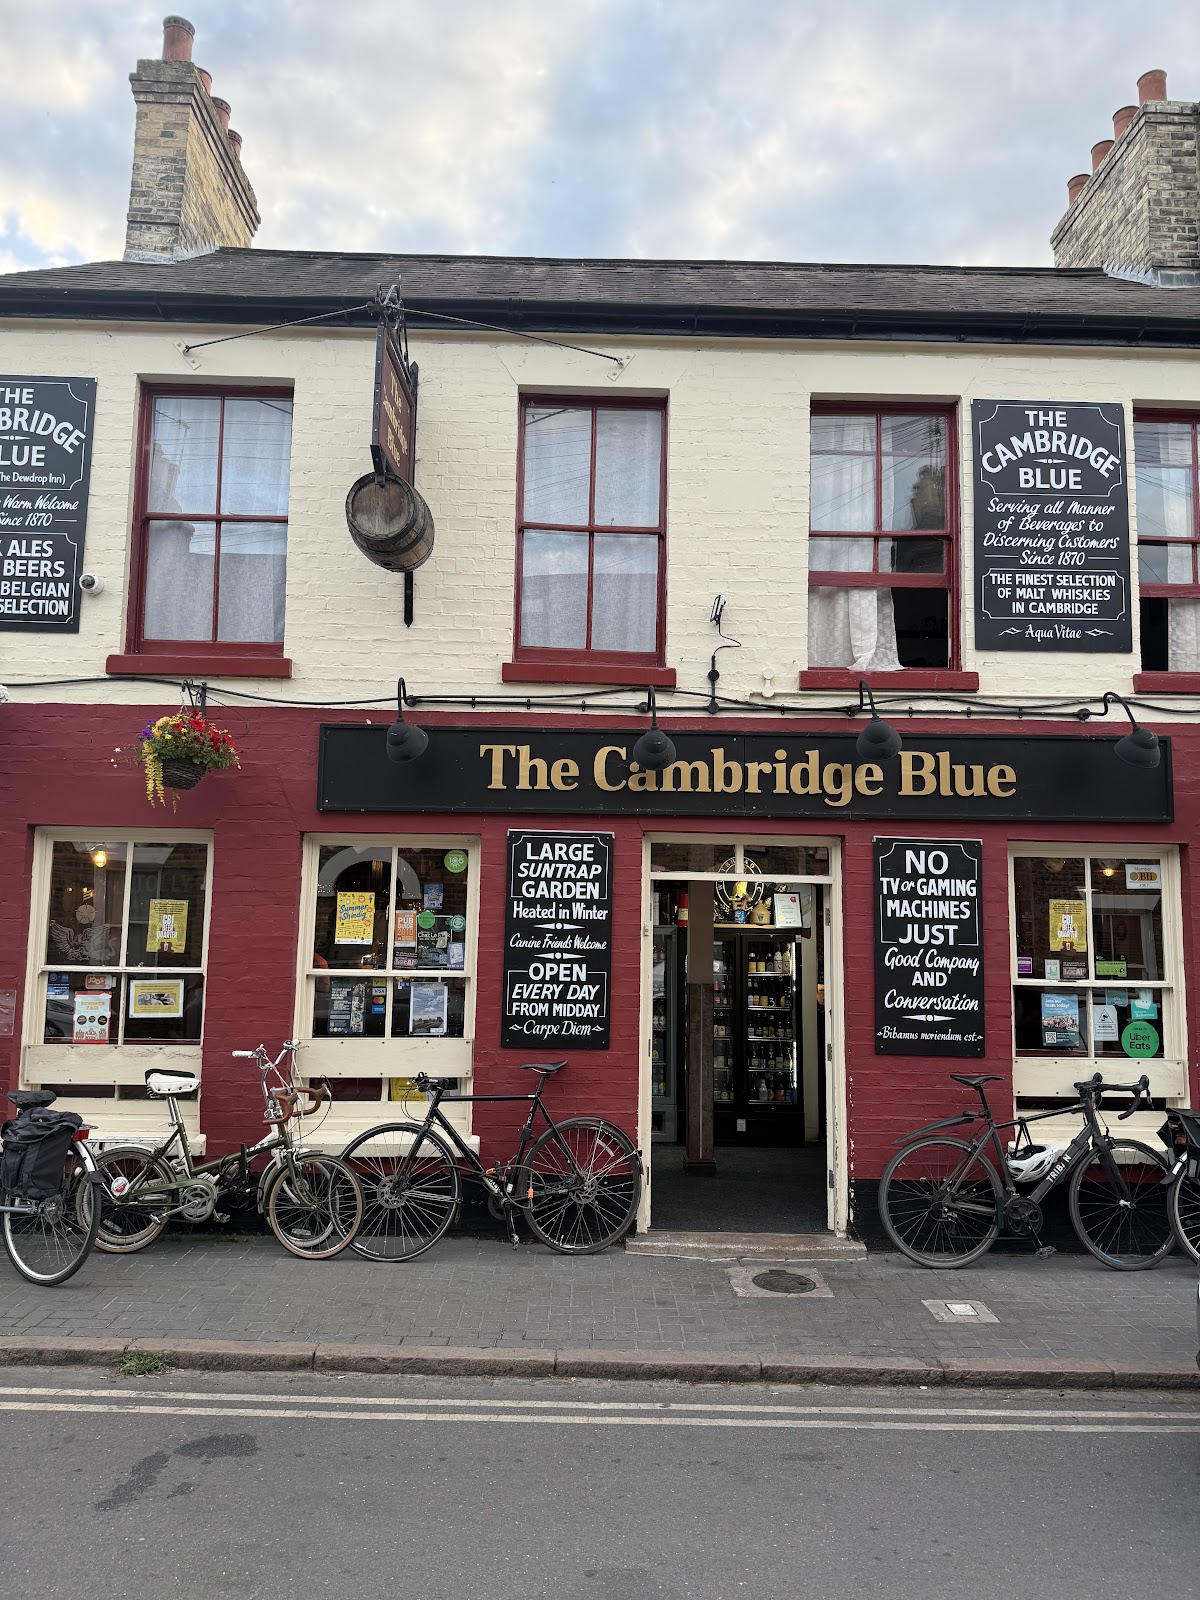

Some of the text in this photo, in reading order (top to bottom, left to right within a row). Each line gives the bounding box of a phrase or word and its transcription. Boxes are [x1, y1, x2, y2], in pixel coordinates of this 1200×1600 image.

[390, 370, 402, 414] The
[1025, 410, 1067, 427] THE
[387, 425, 400, 468] Blue
[982, 430, 1120, 478] CAMBRIDGE
[0, 471, 66, 485] he Dewdrop Inn)
[1019, 467, 1083, 490] BLUE
[3, 493, 79, 510] Warm Welcome
[987, 497, 1116, 518] Serving all Manner
[25, 512, 53, 527] 1870
[997, 516, 1104, 535] of Beverages to
[7, 540, 53, 557] ALES
[983, 531, 1120, 552] Discerning Customers
[1020, 550, 1086, 566] Since 1870
[3, 560, 65, 578] BEERS
[989, 573, 1116, 587] THE FINEST SELECTION
[0, 581, 70, 598] BELGIAN
[997, 587, 1111, 601] OF MALT WHISKIES
[1012, 601, 1099, 615] IN CAMBRIDGE
[1024, 624, 1082, 642] Aqua Vitae
[479, 744, 1017, 807] The Cambridge Blue
[526, 843, 595, 862] LARGE
[517, 863, 602, 879] SUNTRAP
[905, 850, 949, 875] NO
[521, 881, 600, 899] GARDEN
[880, 877, 900, 895] TV
[916, 878, 977, 897] GAMING
[339, 904, 369, 914] Summer
[341, 911, 367, 922] Shindig
[512, 901, 609, 920] Heated in Winter
[886, 900, 971, 919] MACHINES
[397, 917, 414, 925] PUB
[397, 928, 414, 936] 2010
[898, 924, 959, 945] JUST
[509, 933, 607, 950] Canine Friends Welcome
[884, 947, 980, 976] Good Company
[528, 963, 587, 982] OPEN
[911, 971, 948, 987] AND
[511, 984, 601, 1001] EVERY DAY
[884, 988, 979, 1011] Conversation
[511, 1002, 601, 1018] FROM MIDDAY
[523, 1020, 592, 1040] Carpe Diem
[882, 1025, 919, 1040] Bibamus
[920, 1028, 961, 1041] moriendum
[1129, 1032, 1151, 1041] Uber
[1129, 1041, 1151, 1050] Eats
[1045, 1153, 1072, 1183] TRIBN
